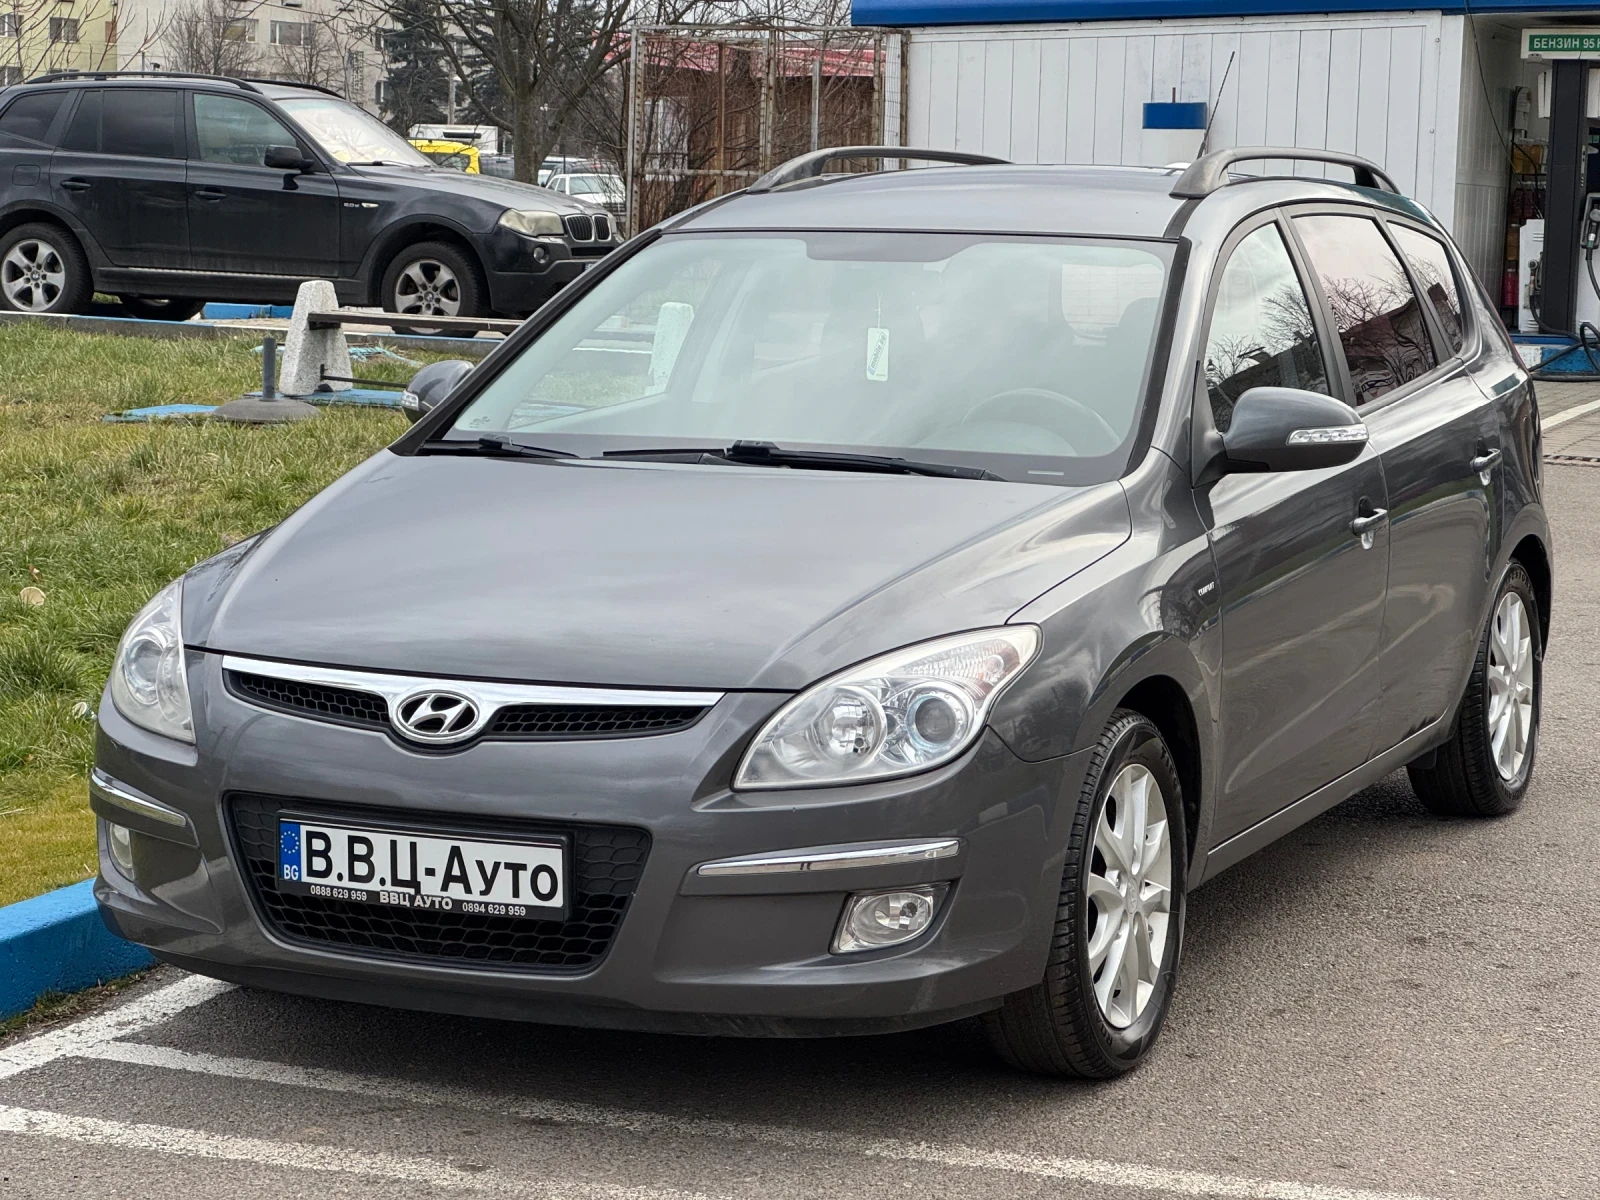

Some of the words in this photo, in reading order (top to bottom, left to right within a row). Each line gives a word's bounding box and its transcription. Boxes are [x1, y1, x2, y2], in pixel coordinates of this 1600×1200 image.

[1533, 37, 1580, 49] БЕНЗИН
[1583, 38, 1596, 49] 95
[283, 864, 299, 880] BG
[310, 885, 331, 896] 0888
[332, 888, 349, 899] 629
[350, 890, 367, 901] 959
[379, 891, 410, 907] ВВЦ
[413, 895, 453, 910] АУТО
[462, 902, 486, 913] 0894
[487, 904, 506, 915] 629
[508, 906, 526, 917] 959
